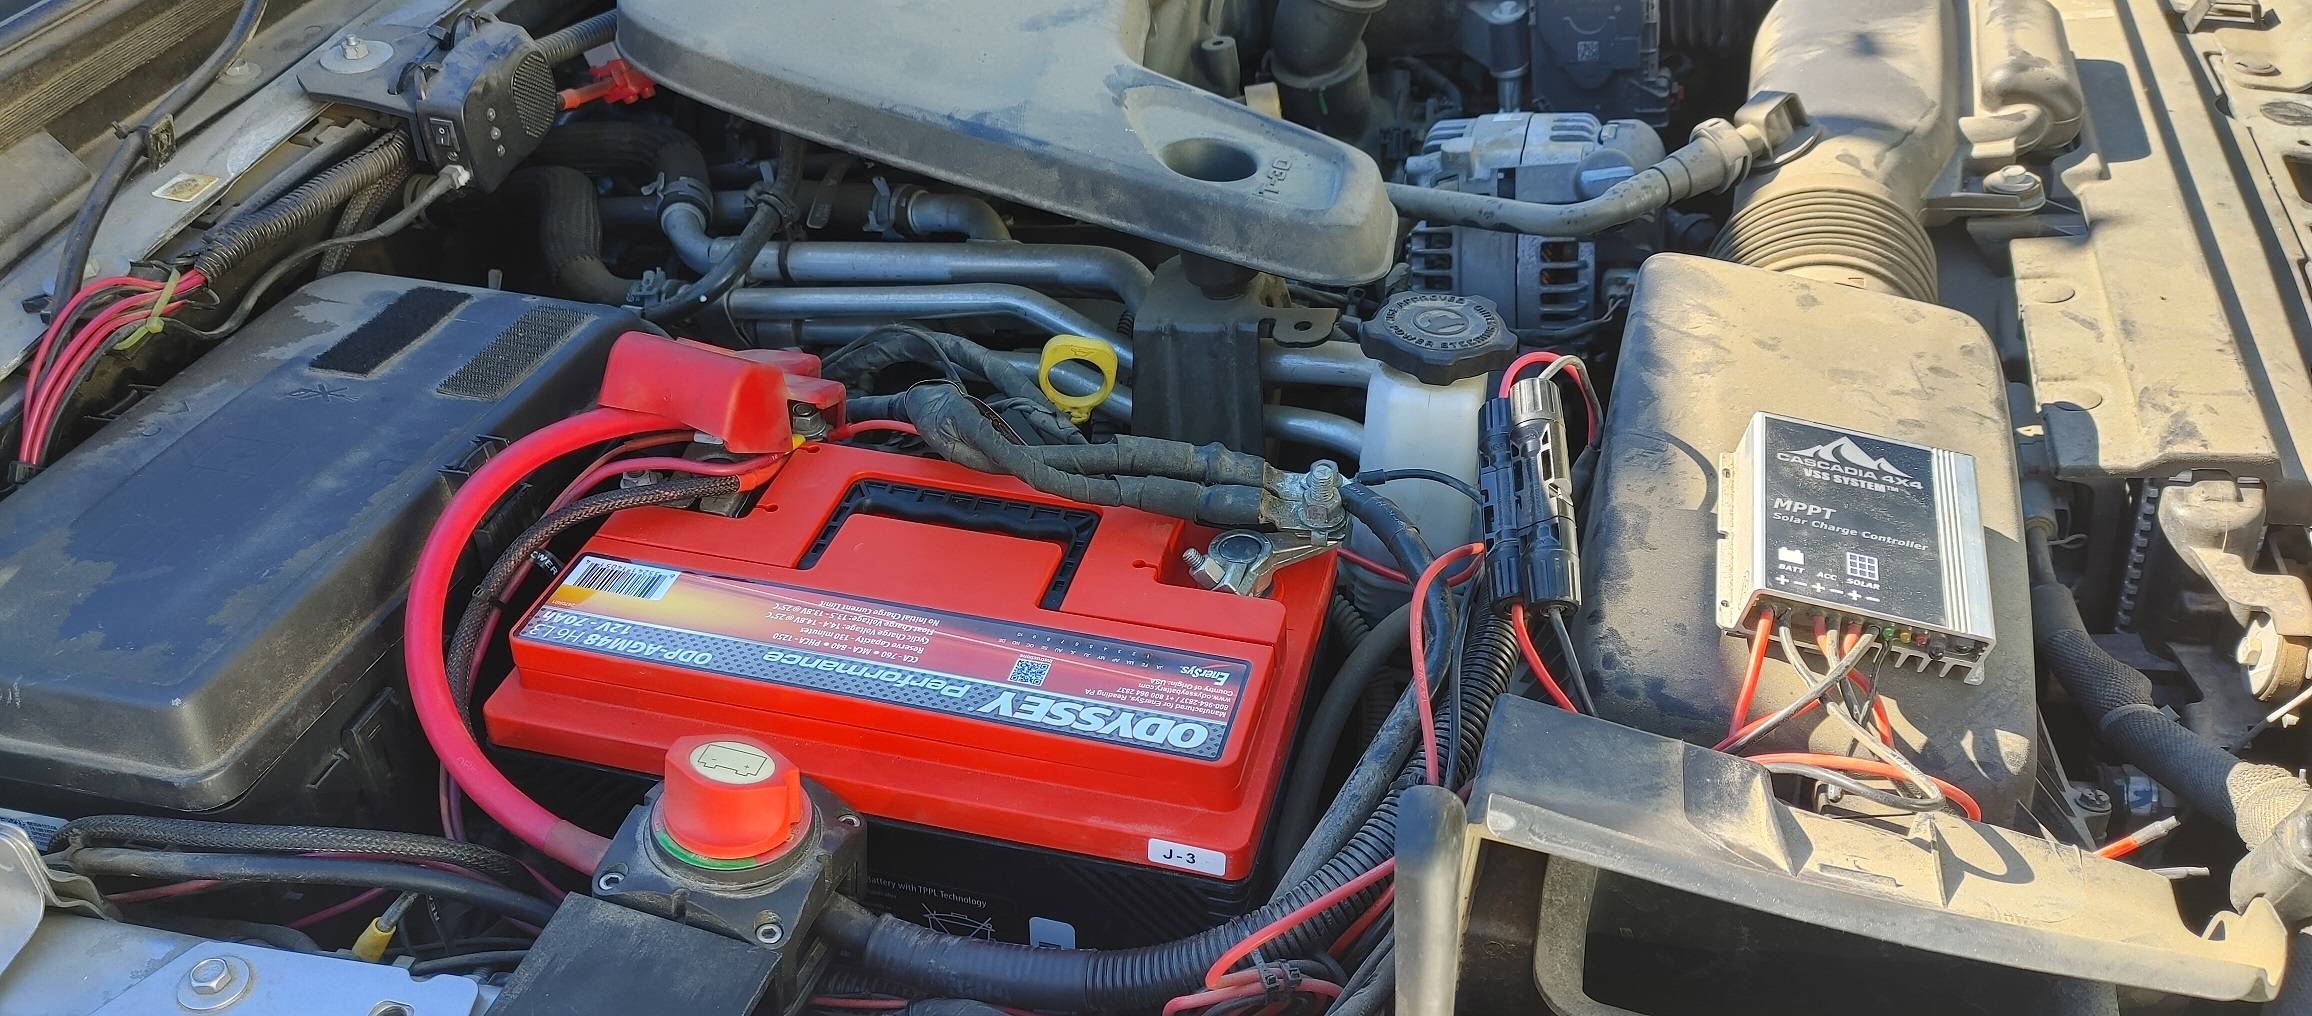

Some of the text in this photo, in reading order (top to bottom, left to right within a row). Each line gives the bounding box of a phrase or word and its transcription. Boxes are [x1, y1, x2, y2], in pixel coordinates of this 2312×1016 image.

[1776, 451, 1879, 480] CASCADIA
[1803, 467, 1831, 481] VSS
[1773, 497, 1837, 520] MPPT
[1772, 512, 1929, 551] Solar Charge Controller
[1778, 563, 1880, 590] BATT ACC SOLAR
[800, 607, 824, 617] 13.8V
[819, 600, 940, 627] No Initial Charge Current Limit
[829, 612, 847, 621] 13.5
[542, 611, 589, 628] 70Ah
[793, 616, 817, 626] 14.8V
[823, 621, 841, 630] 14.4
[848, 615, 883, 627] Voltage:
[598, 621, 632, 634] 12V
[841, 624, 876, 636] Voltage:
[883, 620, 912, 632] Charge
[912, 627, 935, 636] Float
[772, 632, 793, 642] 1250
[800, 627, 834, 638] minutes
[833, 633, 850, 641] 130
[877, 629, 906, 641] Charge
[798, 636, 822, 647] PHCA
[855, 635, 891, 648] Capacity
[906, 635, 930, 645] Cyclic
[831, 642, 848, 651] 840
[852, 646, 872, 655] MCA
[891, 642, 925, 654] Reserve
[881, 651, 897, 660] 760
[903, 655, 919, 663] CCA
[530, 623, 1208, 749] ODYSSEY Performance ODP-AGM48 H6 L3
[1167, 680, 1193, 690] Origin:
[1096, 689, 1127, 701] Reading
[1138, 683, 1231, 703] www.odysseybattery.com
[1203, 686, 1233, 697] Country
[1181, 697, 1229, 711] 800-964-2837
[1174, 703, 1227, 718] Manufactured
[898, 882, 917, 893] with
[918, 885, 938, 897] TPPL
[939, 889, 987, 909] Technology
